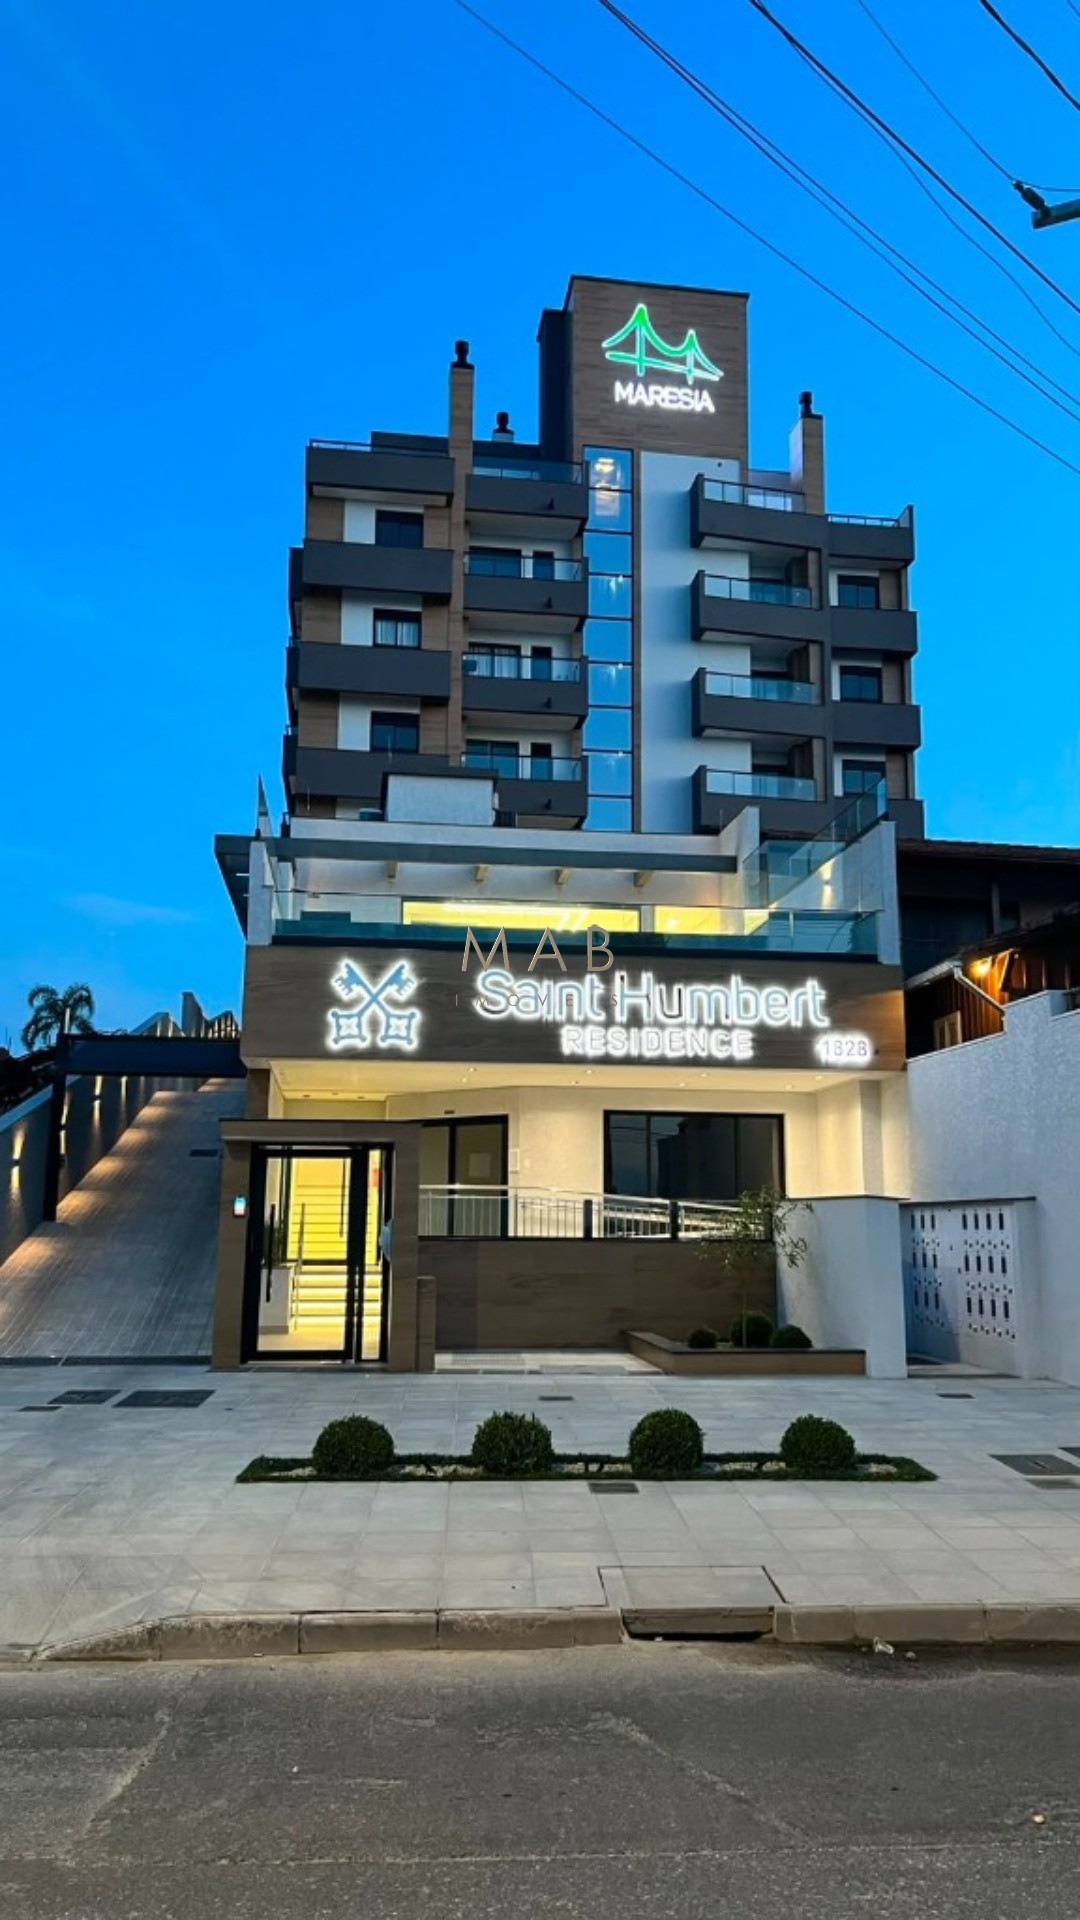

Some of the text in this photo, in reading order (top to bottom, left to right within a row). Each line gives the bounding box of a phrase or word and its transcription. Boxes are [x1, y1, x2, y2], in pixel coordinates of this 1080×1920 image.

[614, 380, 715, 413] MARESIA
[475, 970, 830, 1027] Saint Humbert
[561, 1025, 754, 1059] RESIDENCE
[819, 1036, 870, 1060] 1828
